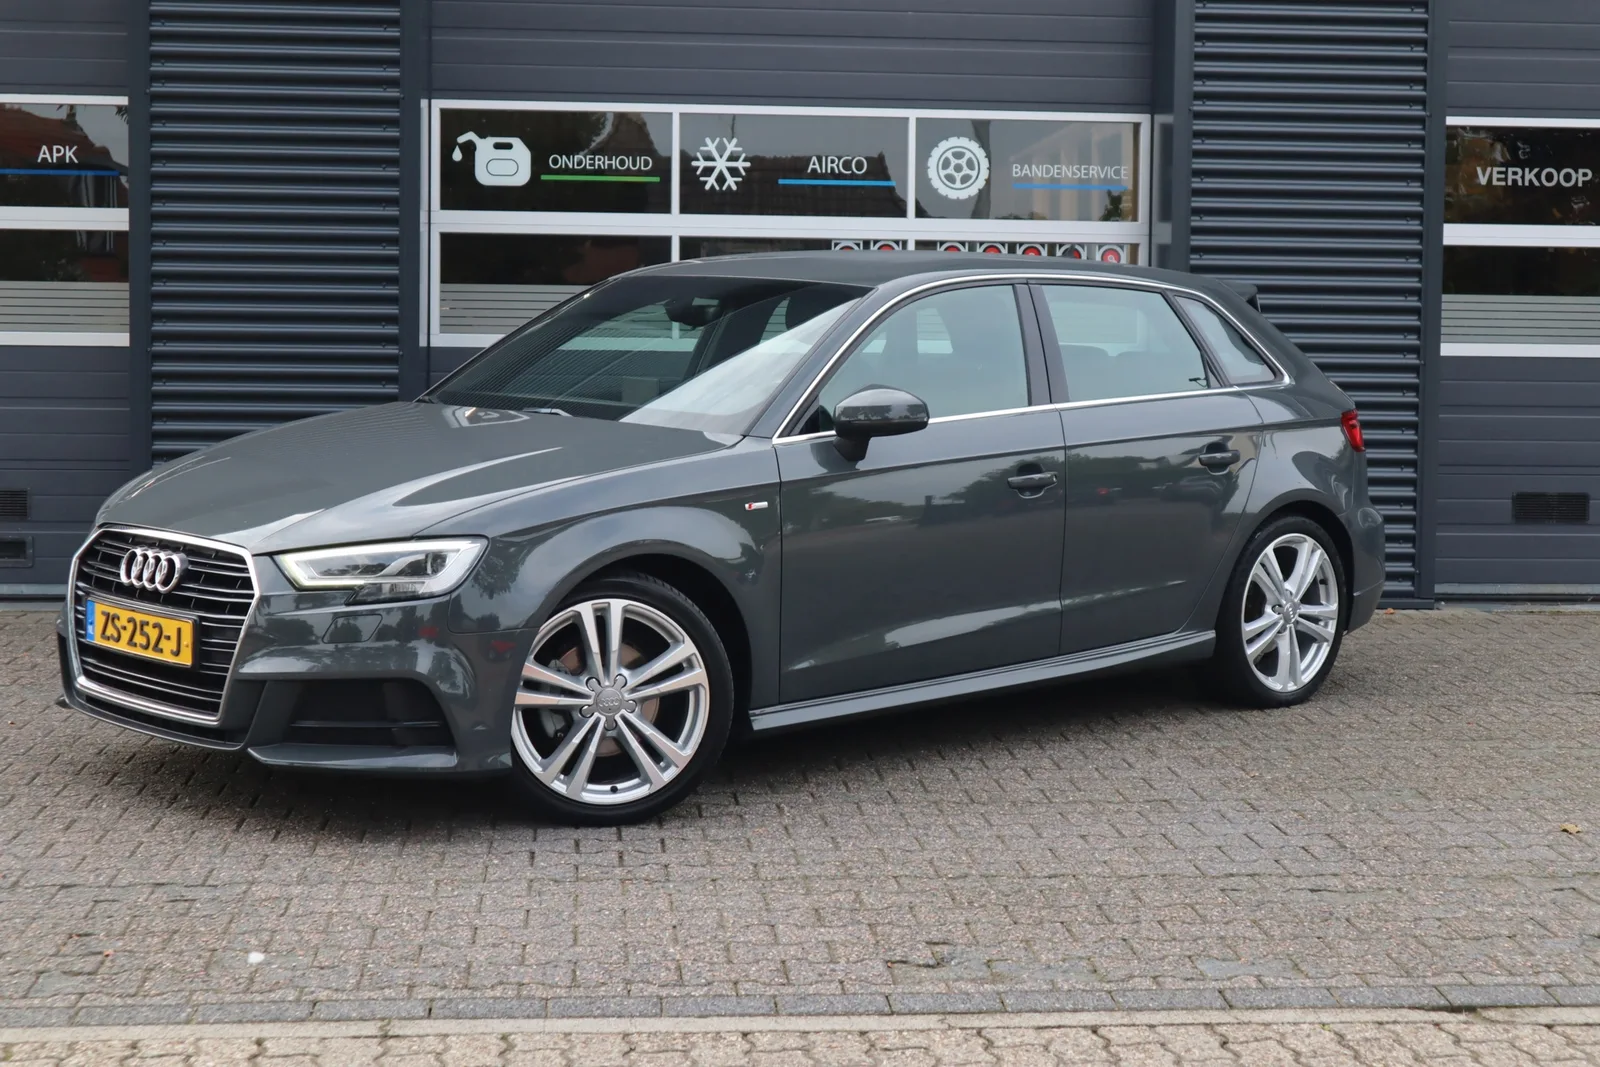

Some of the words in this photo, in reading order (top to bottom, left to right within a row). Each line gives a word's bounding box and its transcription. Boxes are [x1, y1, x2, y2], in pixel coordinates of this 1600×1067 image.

[37, 145, 79, 163] APK
[548, 154, 653, 171] ONDERHOUD
[807, 156, 868, 174] AIRCO
[1012, 163, 1129, 180] BANDENSERVICE
[1476, 166, 1593, 187] VERKOOP
[100, 610, 182, 656] ZS-252-J
